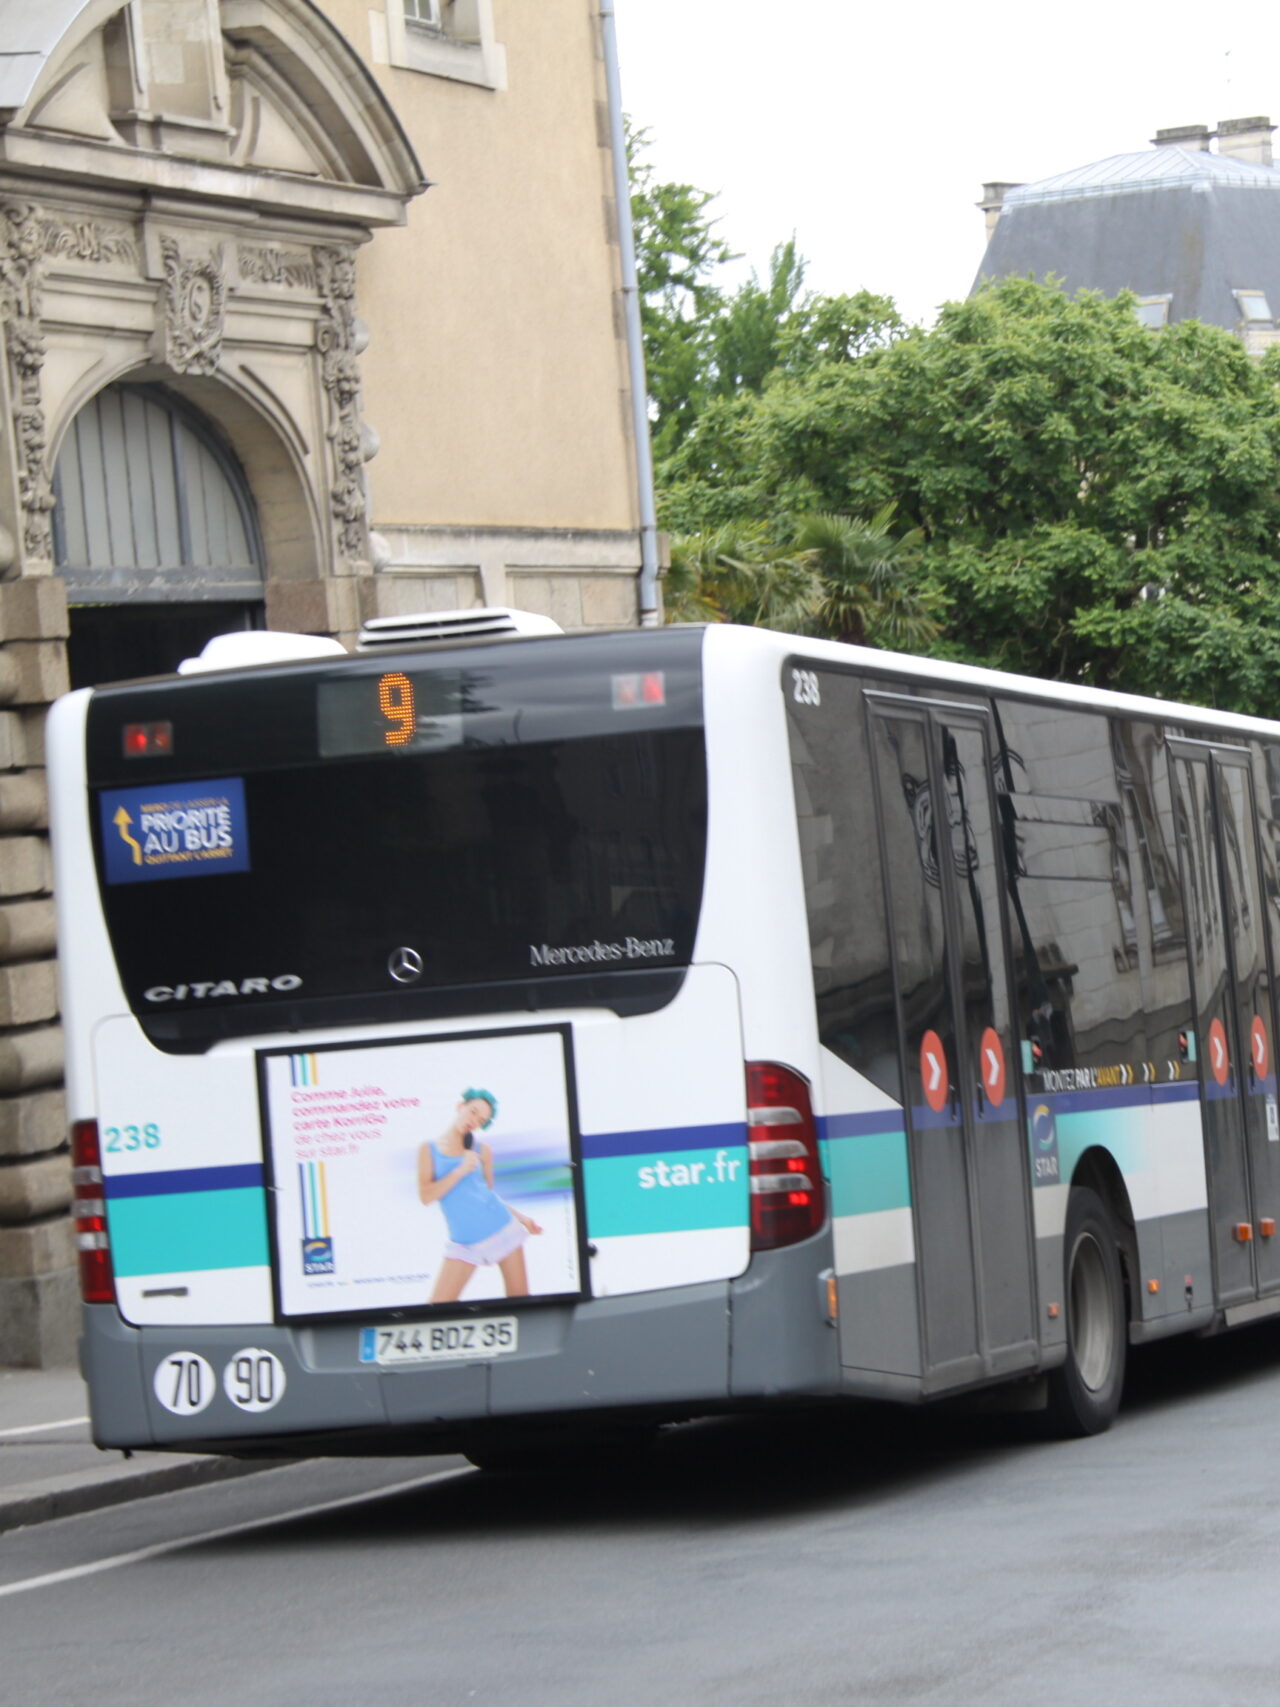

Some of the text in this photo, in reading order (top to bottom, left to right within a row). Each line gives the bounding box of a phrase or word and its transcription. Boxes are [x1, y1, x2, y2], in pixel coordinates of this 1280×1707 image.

[792, 668, 820, 706] 238
[379, 672, 415, 747] 9
[143, 825, 233, 854] AU BUS
[529, 936, 676, 966] Mercedes-Benz
[144, 974, 303, 1002] CITARO
[1043, 1069, 1075, 1091] MONTEZ
[1075, 1067, 1090, 1089] PAR
[291, 1090, 346, 1102] Comme
[292, 1097, 420, 1116] commandez votre
[105, 1123, 161, 1153] 238
[293, 1119, 331, 1131] carte
[638, 1150, 741, 1189] star.fr
[1036, 1155, 1058, 1178] STAR
[379, 1322, 512, 1355] 744 BDZ 35
[170, 1360, 200, 1407] 70
[236, 1356, 273, 1403] 90
